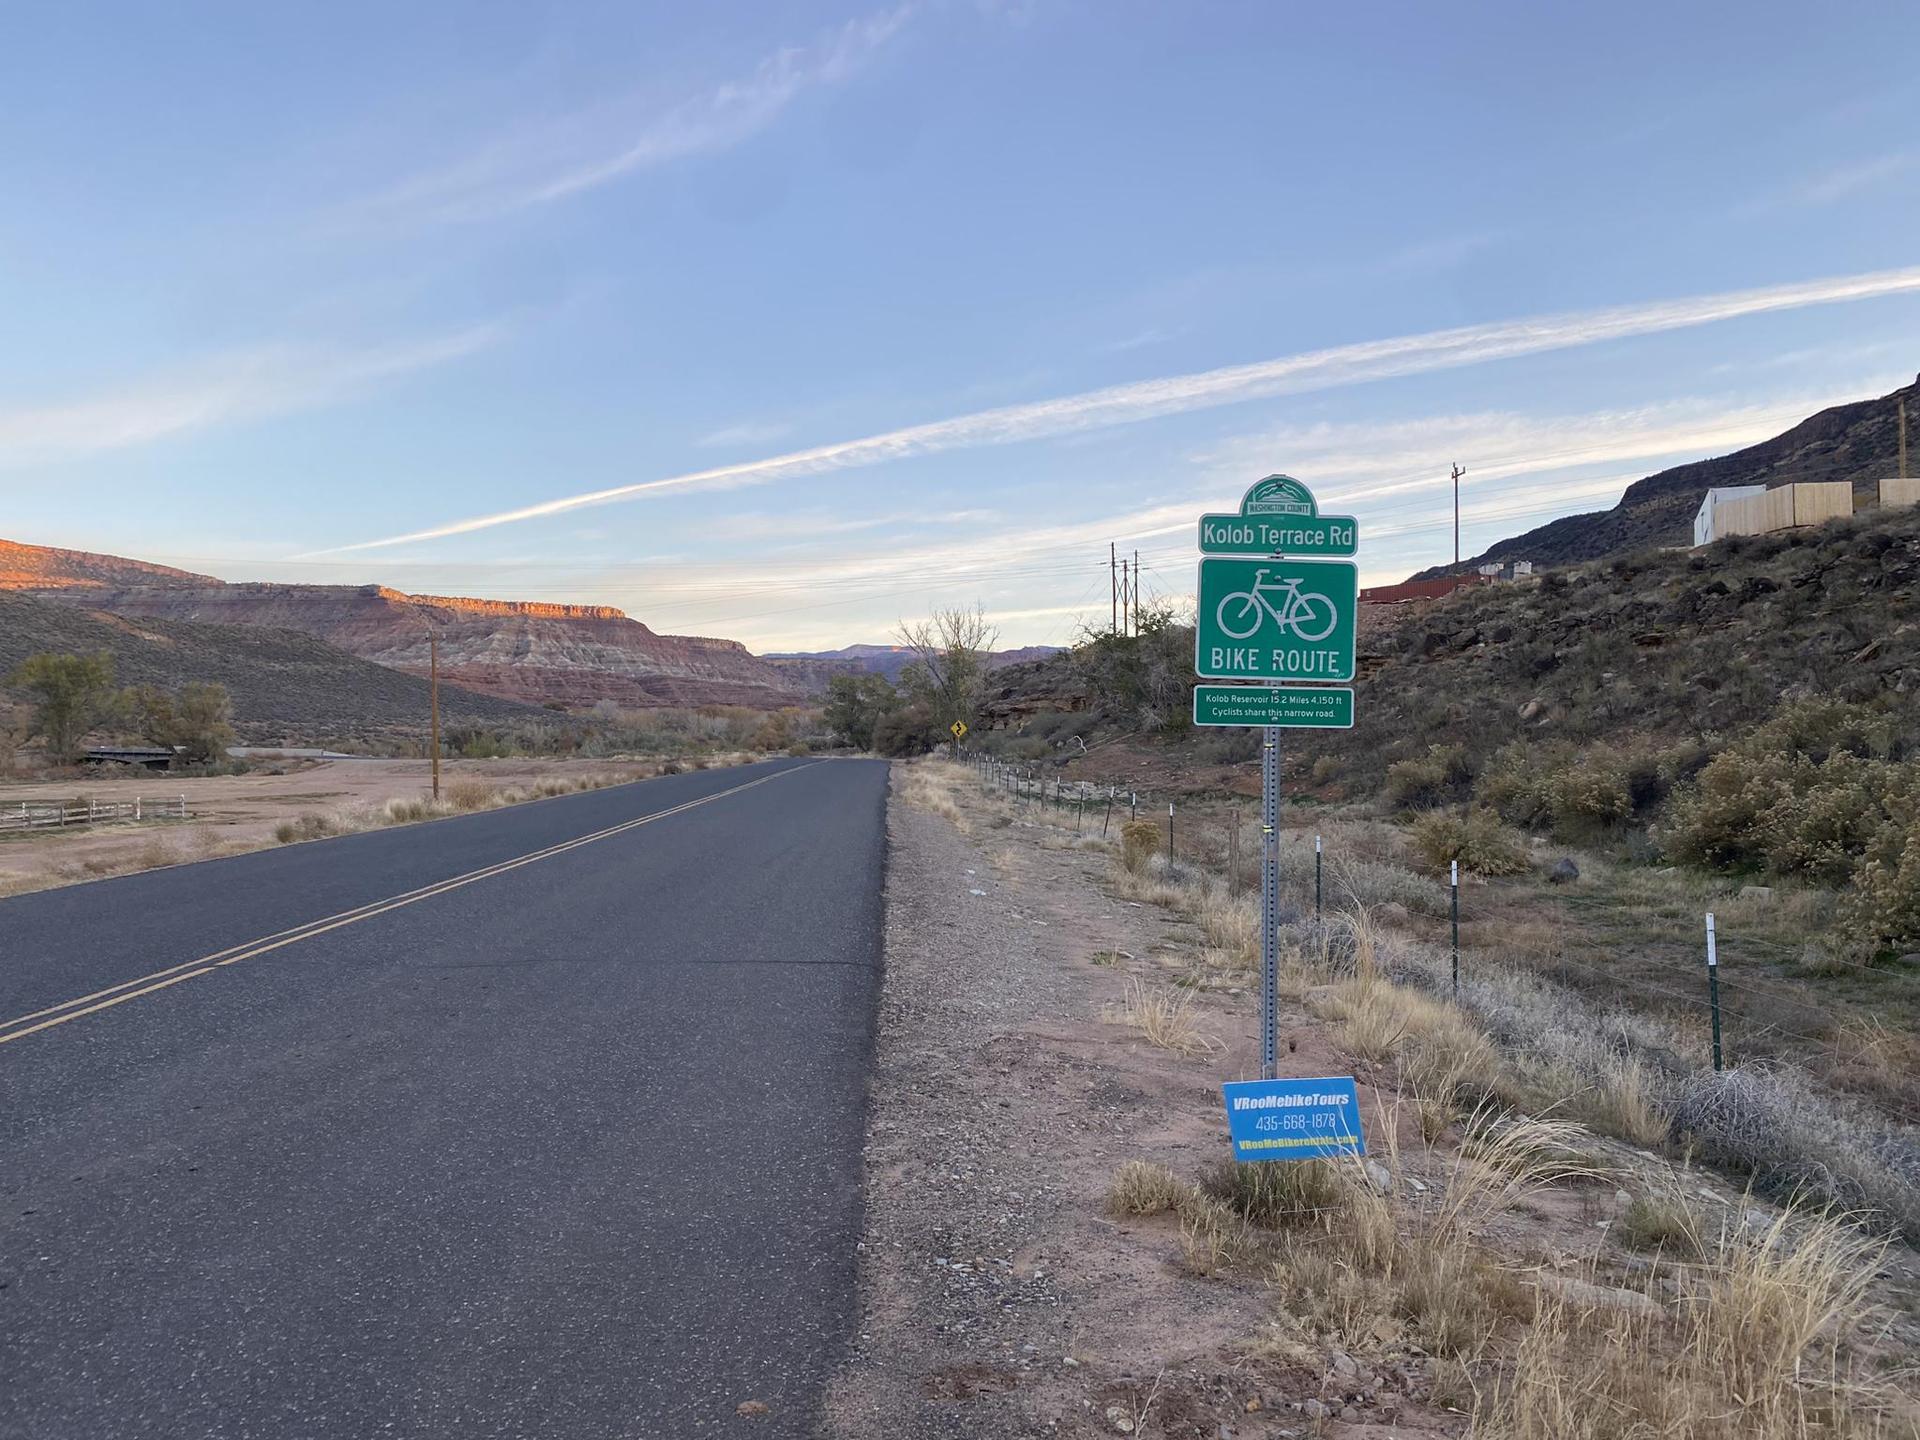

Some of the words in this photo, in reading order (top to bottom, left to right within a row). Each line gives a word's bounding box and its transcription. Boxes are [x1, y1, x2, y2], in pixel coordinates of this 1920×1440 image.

[1286, 504, 1310, 514] COUNTY
[1204, 523, 1254, 544] Kolob
[1258, 524, 1325, 545] Terrace
[1329, 525, 1353, 546] Rd
[1211, 647, 1259, 671] BIKE
[1272, 649, 1340, 673] ROUTE
[1205, 694, 1229, 703] Kolob
[1231, 694, 1269, 704] Reservoir
[1270, 695, 1287, 704] 15.2
[1289, 696, 1310, 705] Miles
[1335, 696, 1342, 705] ft
[1212, 707, 1243, 717] Cyclists
[1244, 708, 1267, 716] share
[1268, 708, 1283, 717] this
[1255, 1113, 1336, 1131] 435-668-1878
